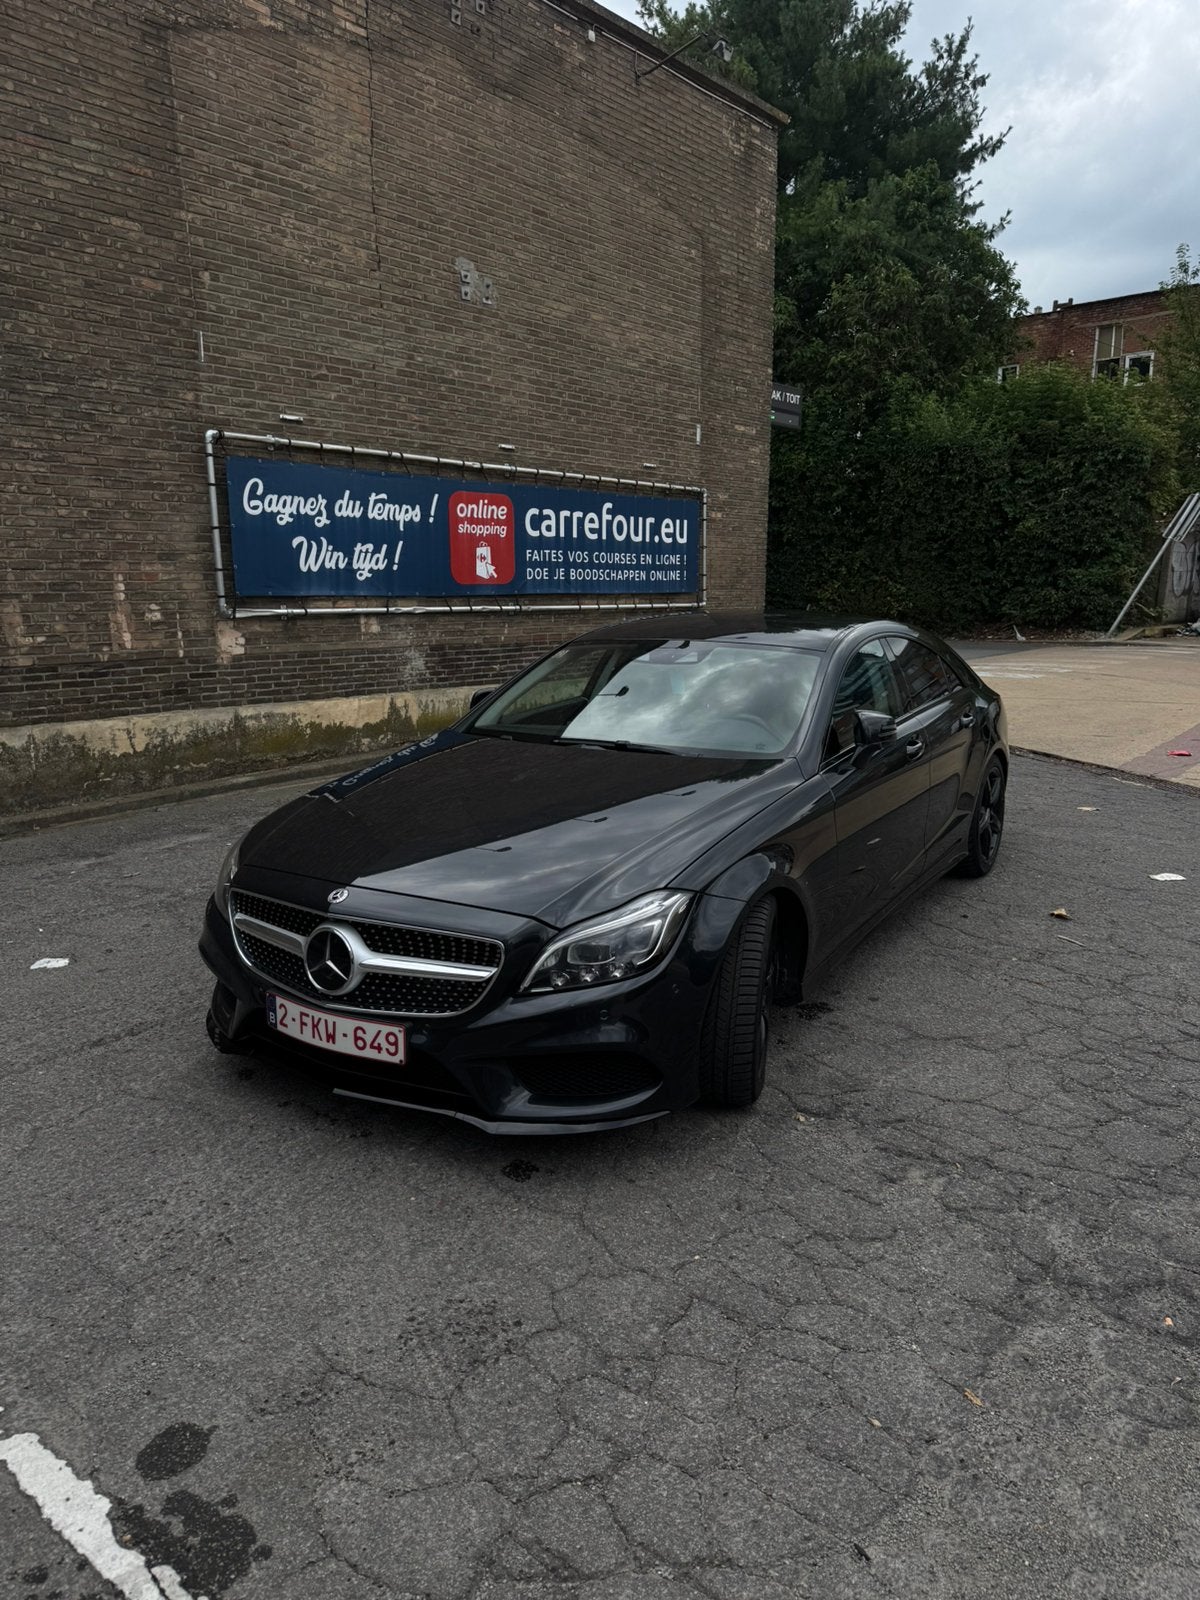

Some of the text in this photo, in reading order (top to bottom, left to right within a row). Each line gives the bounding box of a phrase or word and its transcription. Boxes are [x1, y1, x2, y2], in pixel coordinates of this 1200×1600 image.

[786, 392, 801, 405] TOIT
[242, 477, 439, 531] Gagnez du temps !
[456, 499, 507, 520] online
[457, 521, 507, 538] shopping
[524, 502, 688, 544] carrefour.eu
[291, 535, 403, 581] Win tijd !
[526, 549, 687, 566] FAITES VOS COURSES EN LIGNE !
[526, 568, 687, 581] DOE JE BOODSCHAPPEN ONLINE !
[269, 1011, 276, 1024] B
[279, 1003, 399, 1057] 2-FKW-649
